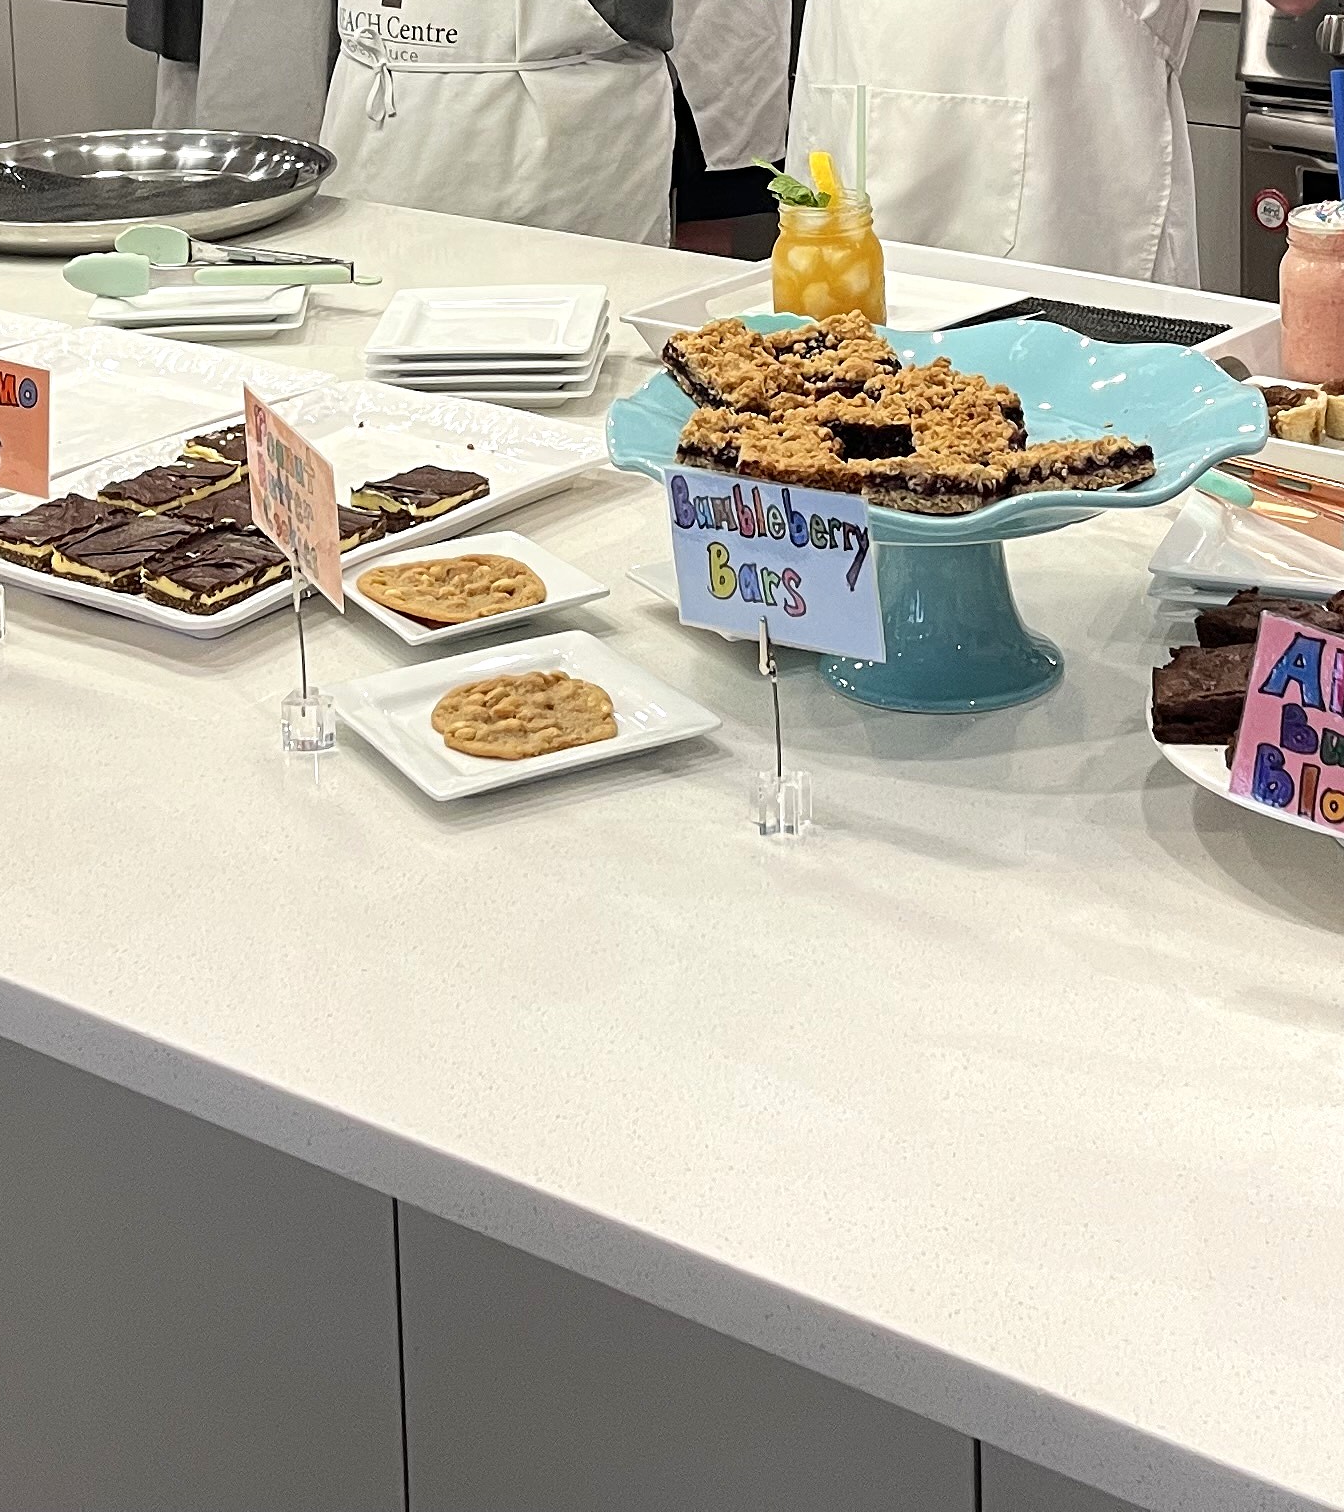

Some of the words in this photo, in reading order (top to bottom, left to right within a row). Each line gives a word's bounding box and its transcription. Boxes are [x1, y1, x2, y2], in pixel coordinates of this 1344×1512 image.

[387, 15, 458, 44] Centre
[670, 474, 870, 592] Bumbleberry
[707, 541, 807, 618] Bars
